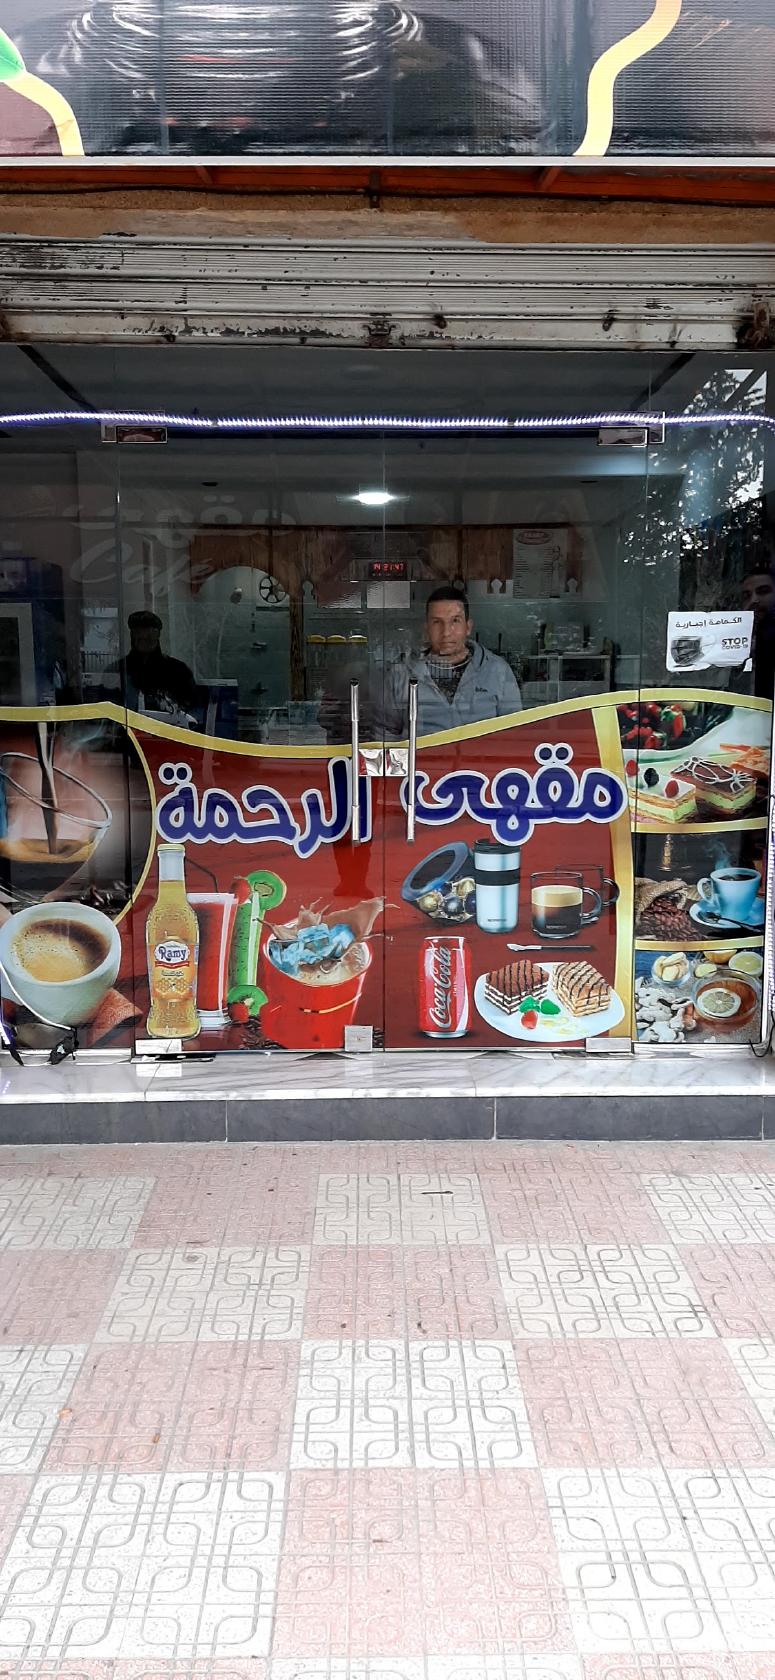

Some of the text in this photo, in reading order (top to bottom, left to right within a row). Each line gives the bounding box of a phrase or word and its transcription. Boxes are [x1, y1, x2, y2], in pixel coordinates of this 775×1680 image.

[721, 637, 748, 645] STOP
[155, 742, 629, 859] مقهى الرحمة
[158, 946, 187, 961] Ramy
